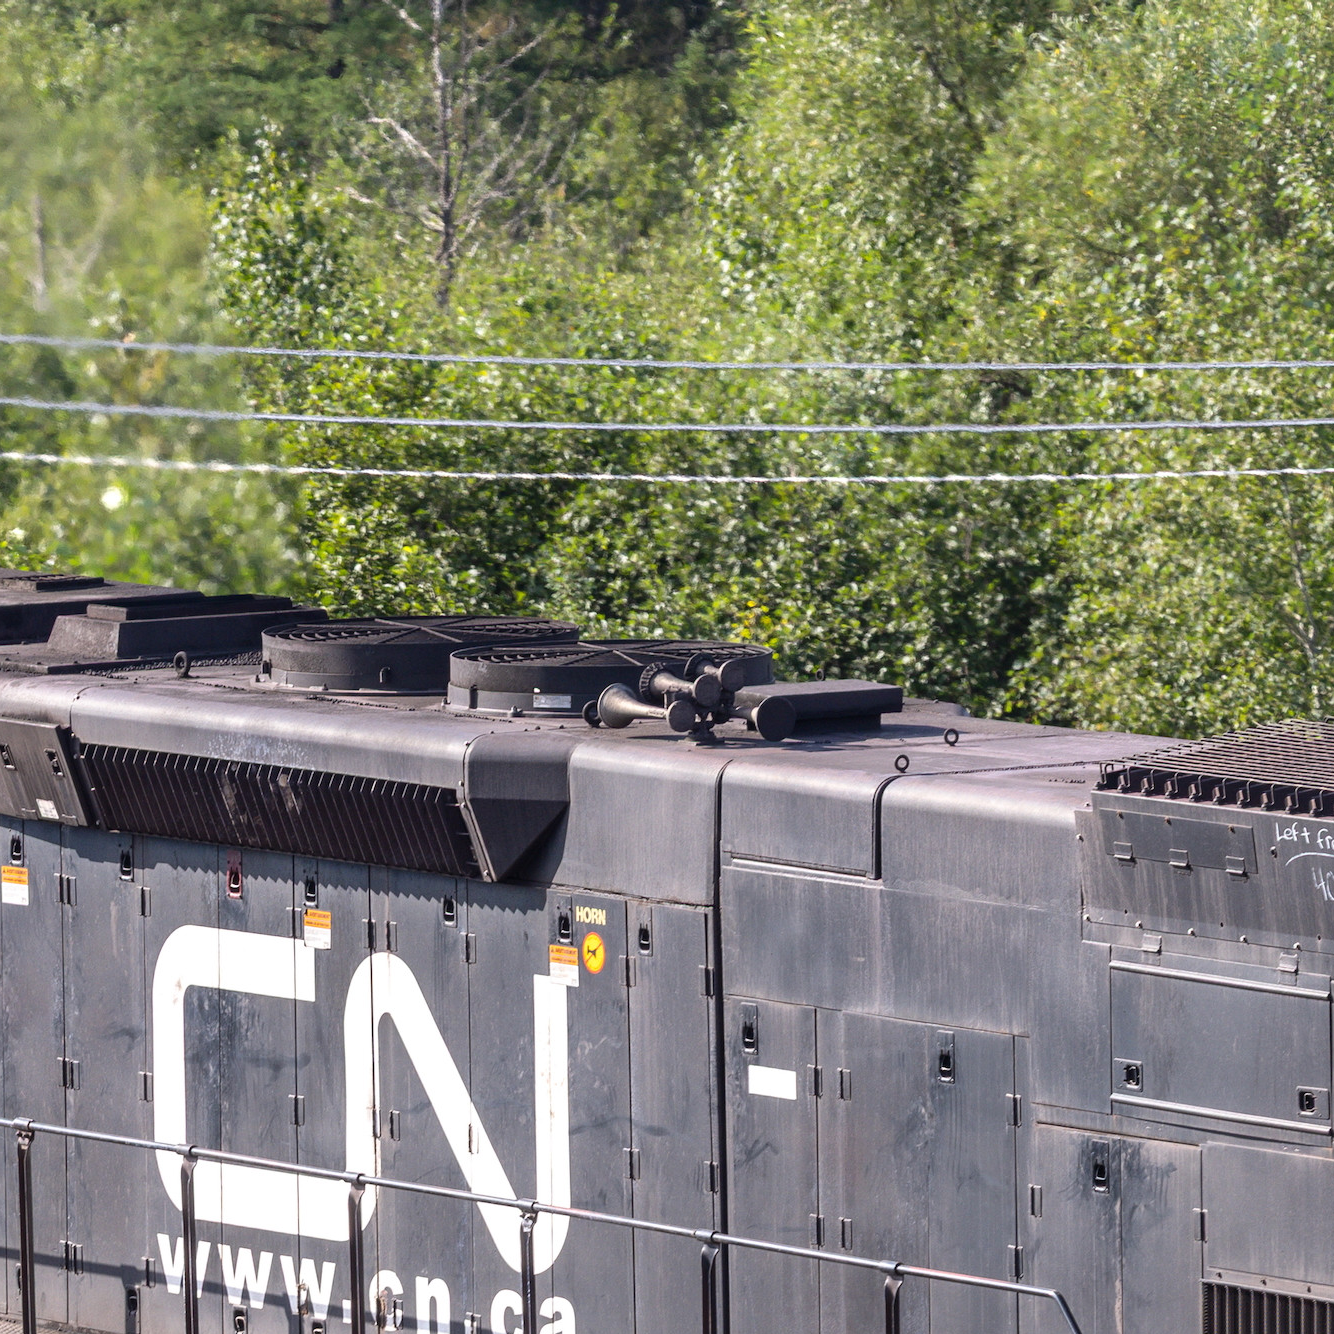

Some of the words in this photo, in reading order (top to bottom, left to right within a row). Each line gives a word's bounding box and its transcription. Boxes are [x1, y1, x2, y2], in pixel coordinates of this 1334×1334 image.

[1274, 822, 1311, 844] Left
[575, 905, 607, 926] HORN
[152, 924, 570, 1275] CN
